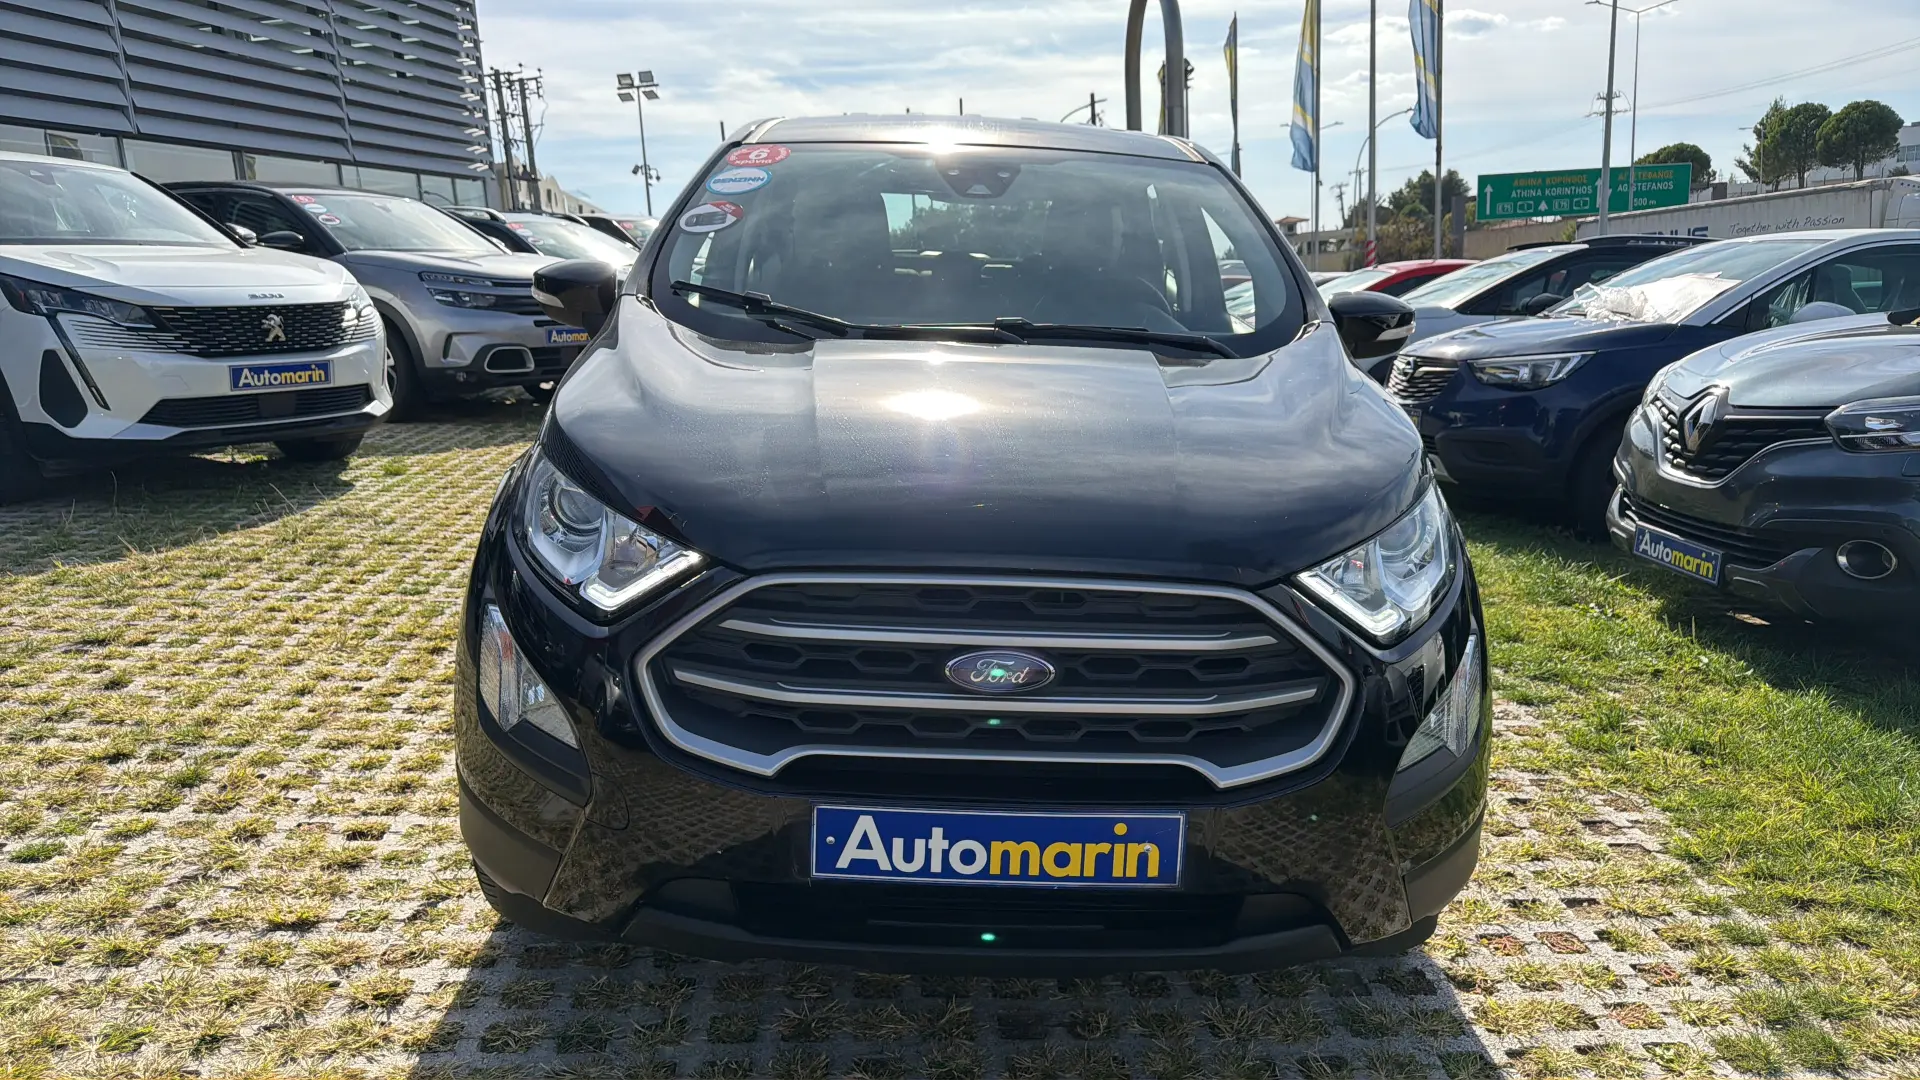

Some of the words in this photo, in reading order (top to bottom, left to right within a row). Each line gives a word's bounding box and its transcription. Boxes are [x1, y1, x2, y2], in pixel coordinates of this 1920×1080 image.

[749, 148, 771, 160] 6
[1510, 188, 1542, 198] ATHINA
[1545, 185, 1593, 197] KORINTHOS
[1632, 181, 1674, 191] STEFANOS
[1634, 198, 1648, 206] 500
[1730, 222, 1771, 236] Together
[1775, 218, 1800, 230] with
[1803, 215, 1845, 227] Passion
[238, 364, 325, 387] Automarin
[1639, 529, 1713, 578] Automarin
[970, 659, 1030, 684] Ford
[835, 814, 1160, 878] Automarin
